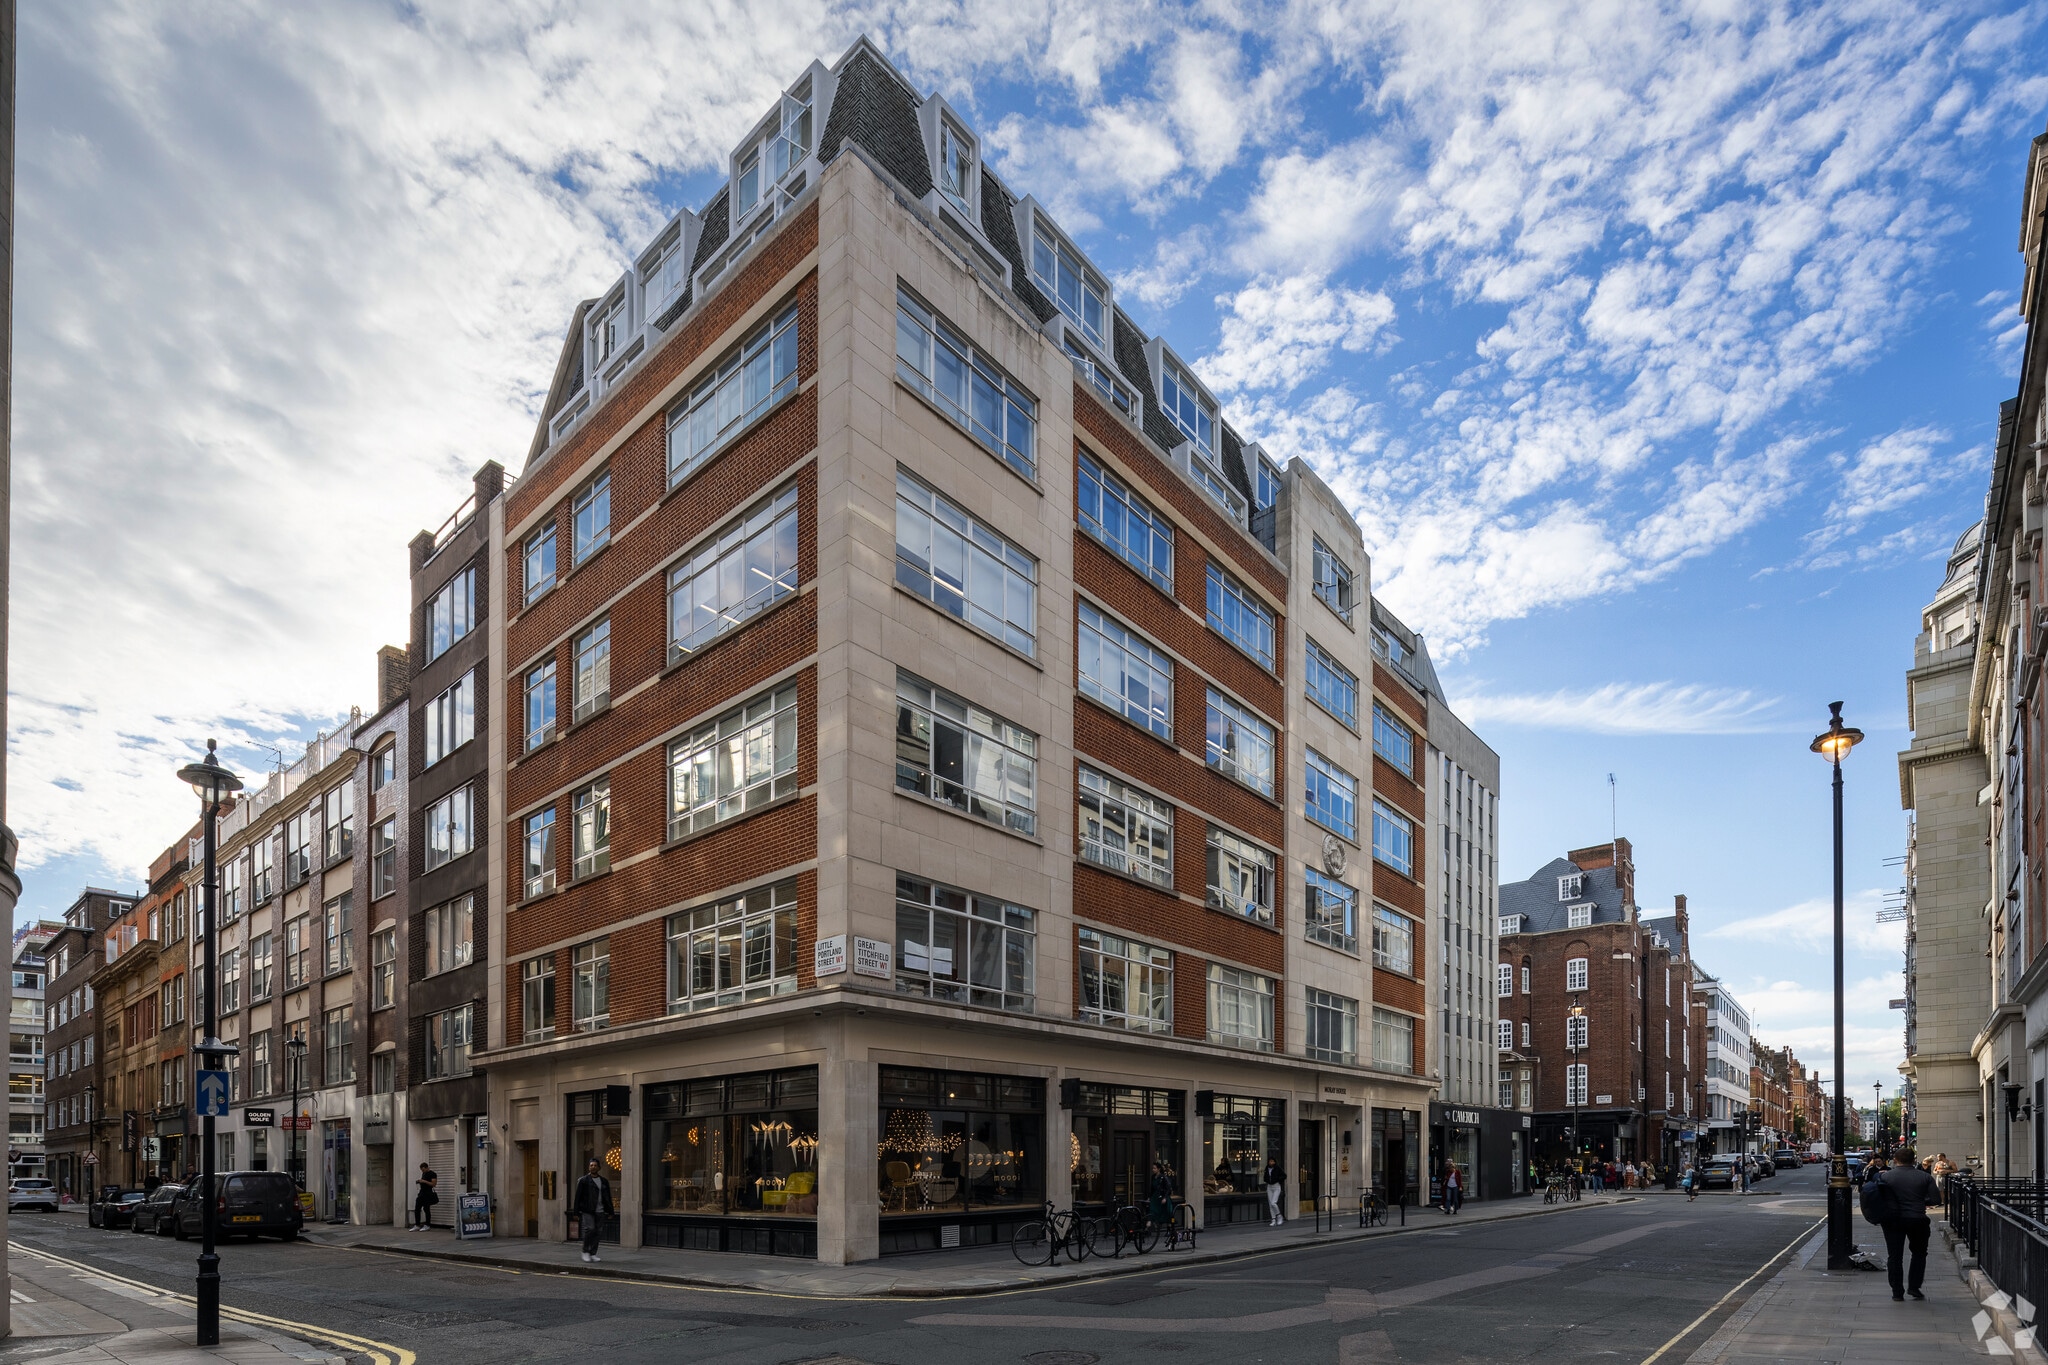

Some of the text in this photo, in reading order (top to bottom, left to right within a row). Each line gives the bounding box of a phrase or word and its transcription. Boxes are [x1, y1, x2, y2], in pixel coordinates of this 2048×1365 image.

[818, 940, 832, 950] LITTLE
[858, 940, 876, 950] GREAT
[818, 947, 842, 959] PORTLAND
[858, 948, 889, 962] TITCHFIELD
[818, 957, 834, 968] STREET
[858, 958, 878, 967] STREET
[1452, 1110, 1480, 1124] CAMERICH
[463, 1197, 485, 1208] F45
